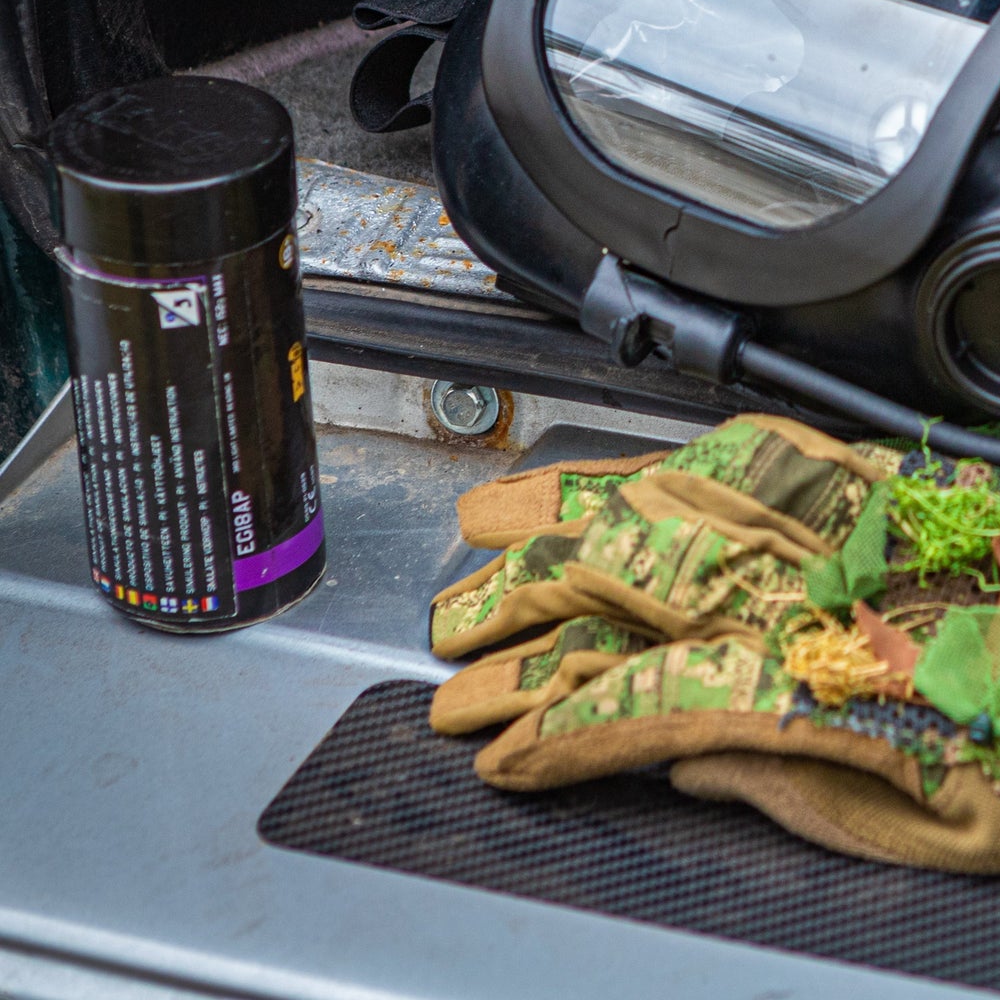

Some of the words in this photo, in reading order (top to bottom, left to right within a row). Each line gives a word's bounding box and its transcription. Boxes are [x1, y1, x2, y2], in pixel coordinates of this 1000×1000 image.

[125, 391, 136, 403] DE
[166, 386, 181, 443] INSTRUKTION
[140, 528, 149, 540] DE
[177, 501, 190, 541] PRODUKT
[231, 490, 255, 556] EG18AP
[141, 542, 154, 591] DISPOSITIVO
[182, 543, 196, 594] SIMULERING
